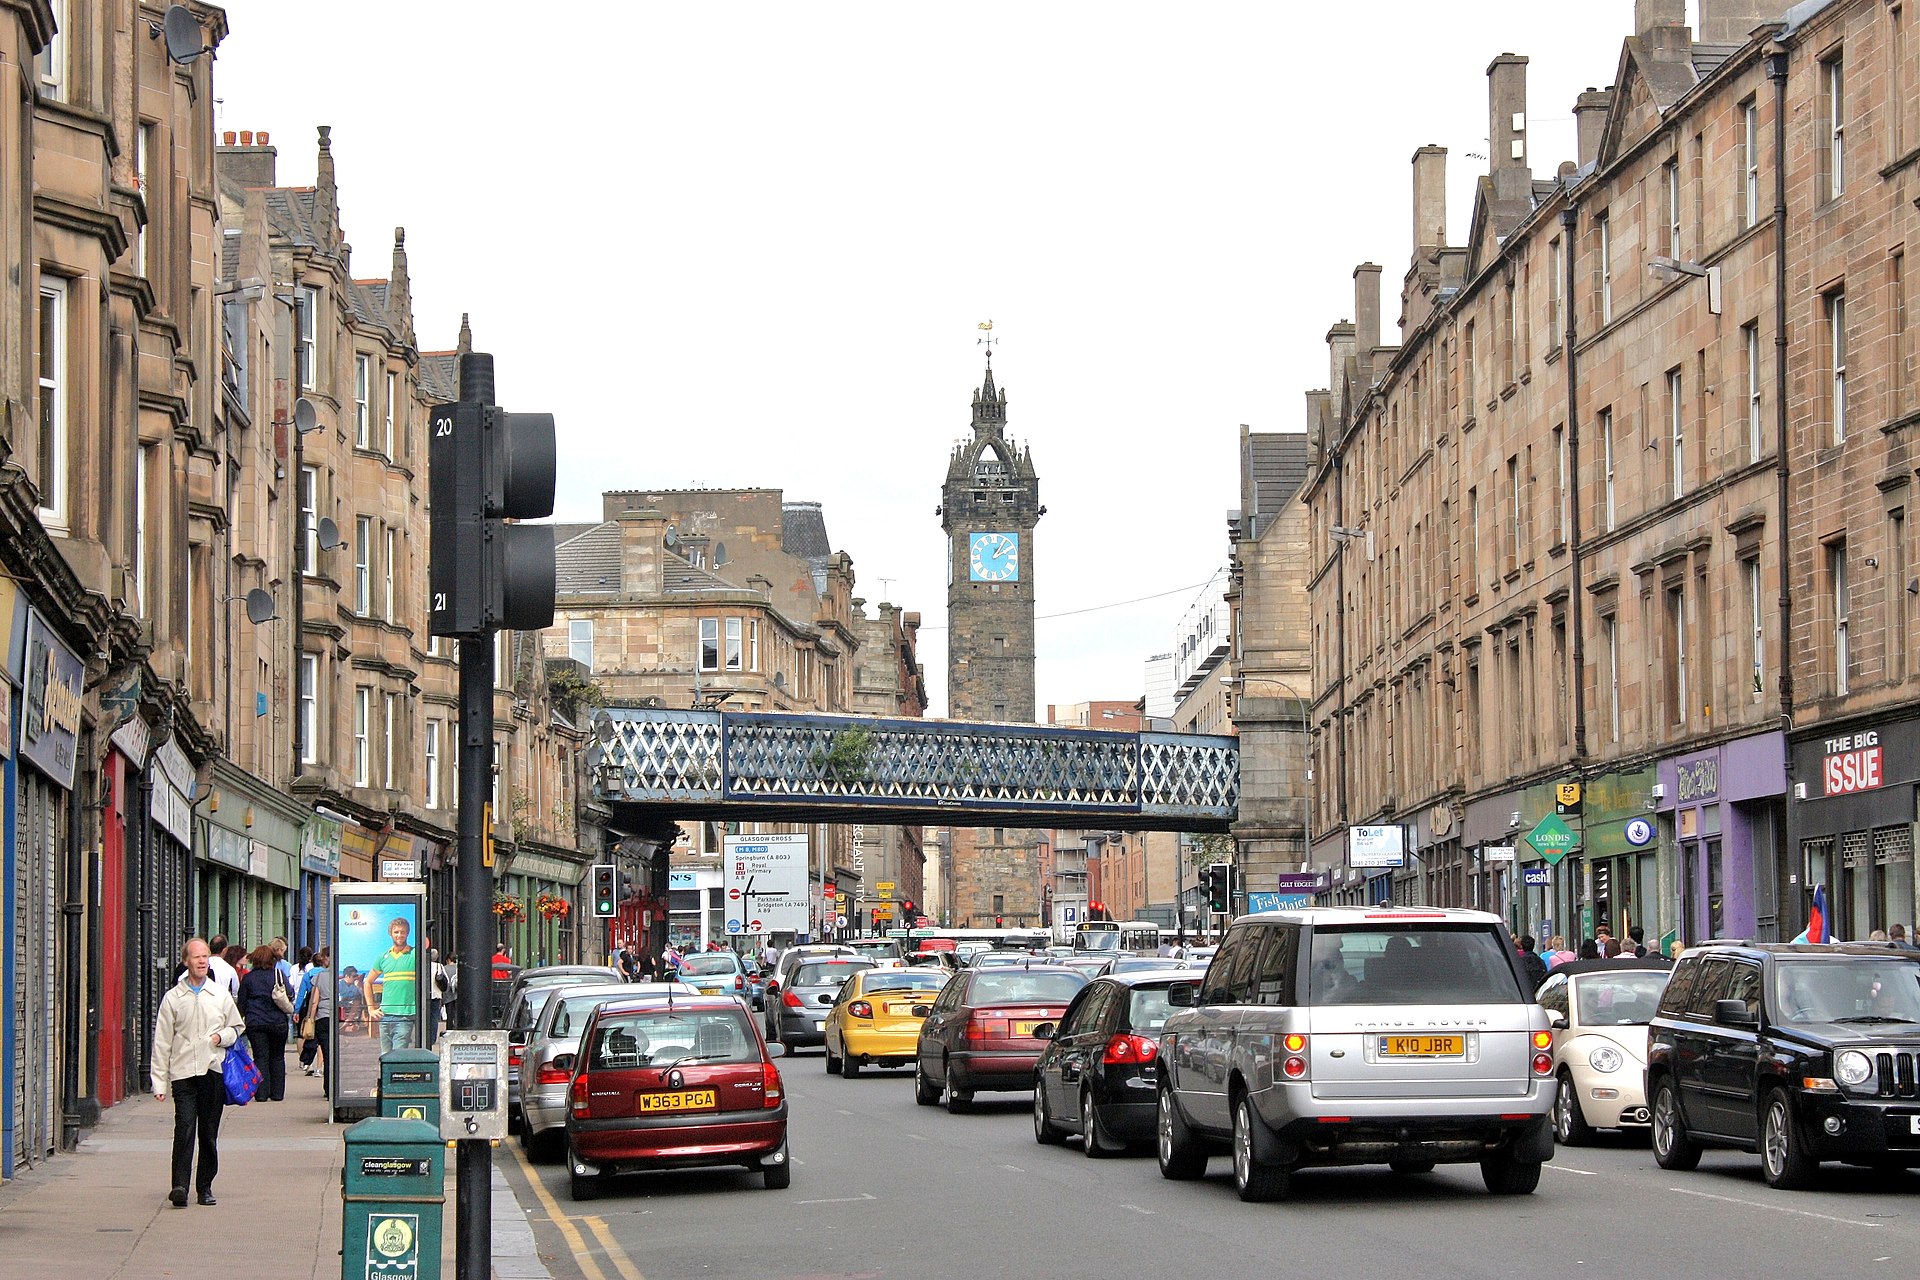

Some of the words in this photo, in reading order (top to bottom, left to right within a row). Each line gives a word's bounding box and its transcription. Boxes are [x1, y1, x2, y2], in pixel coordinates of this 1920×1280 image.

[436, 417, 453, 437] 20
[434, 592, 446, 612] 21
[1825, 736, 1852, 754] THE
[1854, 731, 1878, 749] BIG
[1825, 748, 1879, 794] ISSUE
[1535, 834, 1571, 842] LONDIS
[1256, 894, 1280, 911] Fish
[1424, 1038, 1453, 1052] JBR
[642, 1095, 681, 1109] W363
[685, 1093, 713, 1106] PGA
[364, 1161, 413, 1170] cleanglasgow
[370, 1271, 413, 1280] Glasgow
